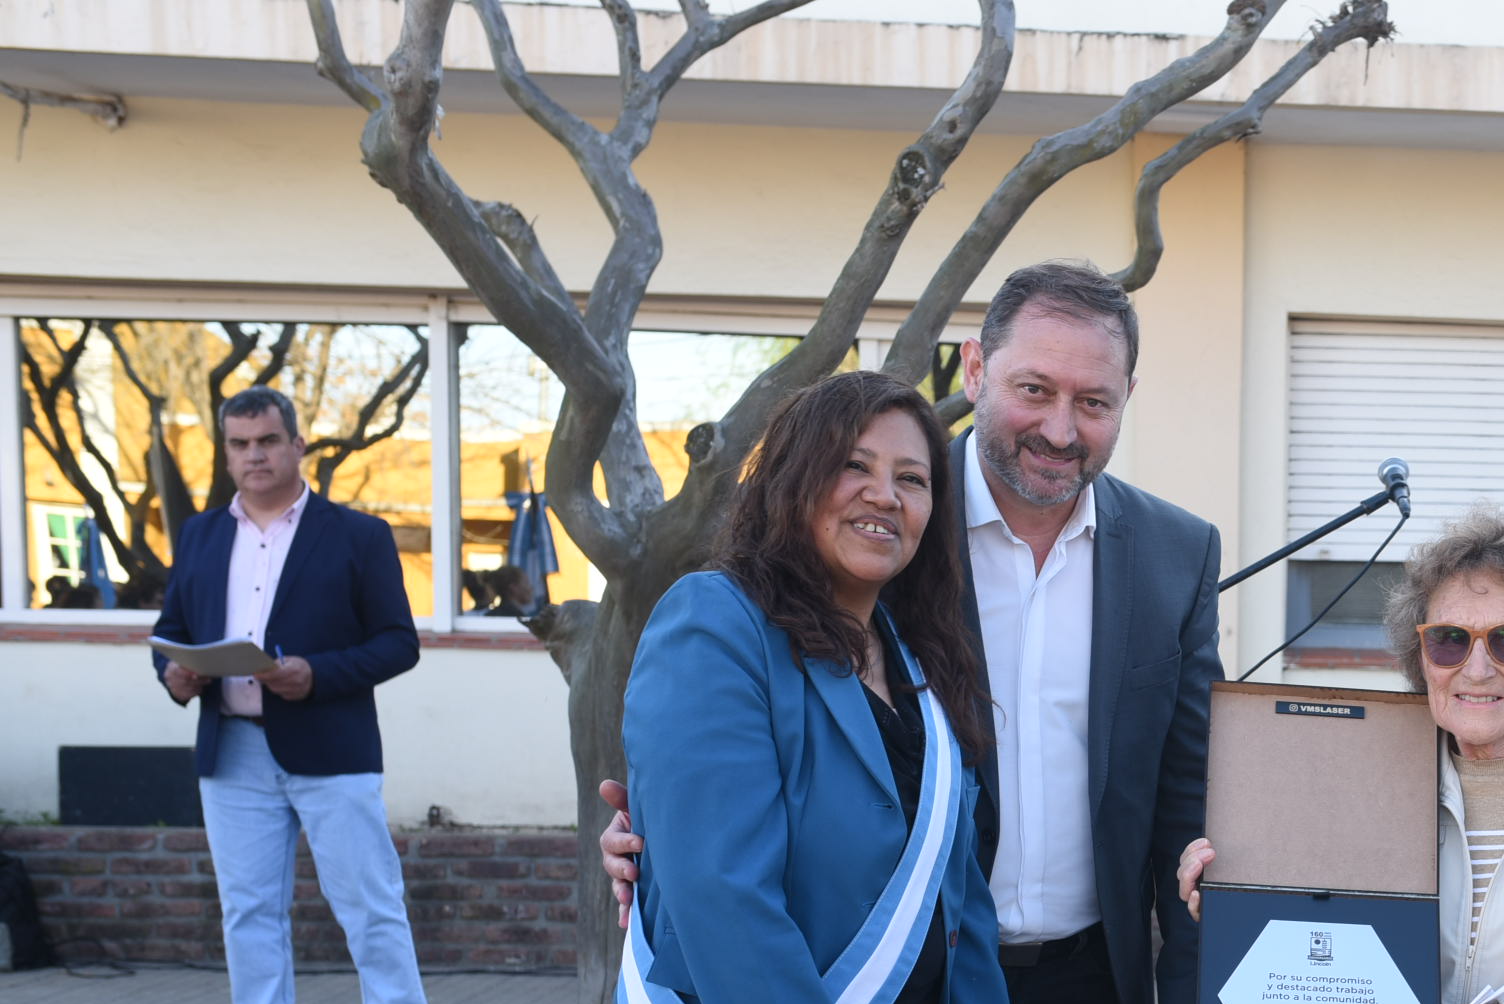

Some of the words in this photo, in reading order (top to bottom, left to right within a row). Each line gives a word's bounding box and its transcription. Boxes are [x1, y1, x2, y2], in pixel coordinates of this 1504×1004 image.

[1299, 705, 1351, 715] VMSLASER
[1269, 972, 1287, 981] Por
[1305, 975, 1373, 985] compromiso
[1266, 983, 1273, 991] y
[1276, 983, 1333, 993] destacado
[1336, 986, 1374, 996] trabajo
[1262, 991, 1290, 1001] junto
[1303, 994, 1312, 1002] la
[1315, 995, 1378, 1004] comunidad.
